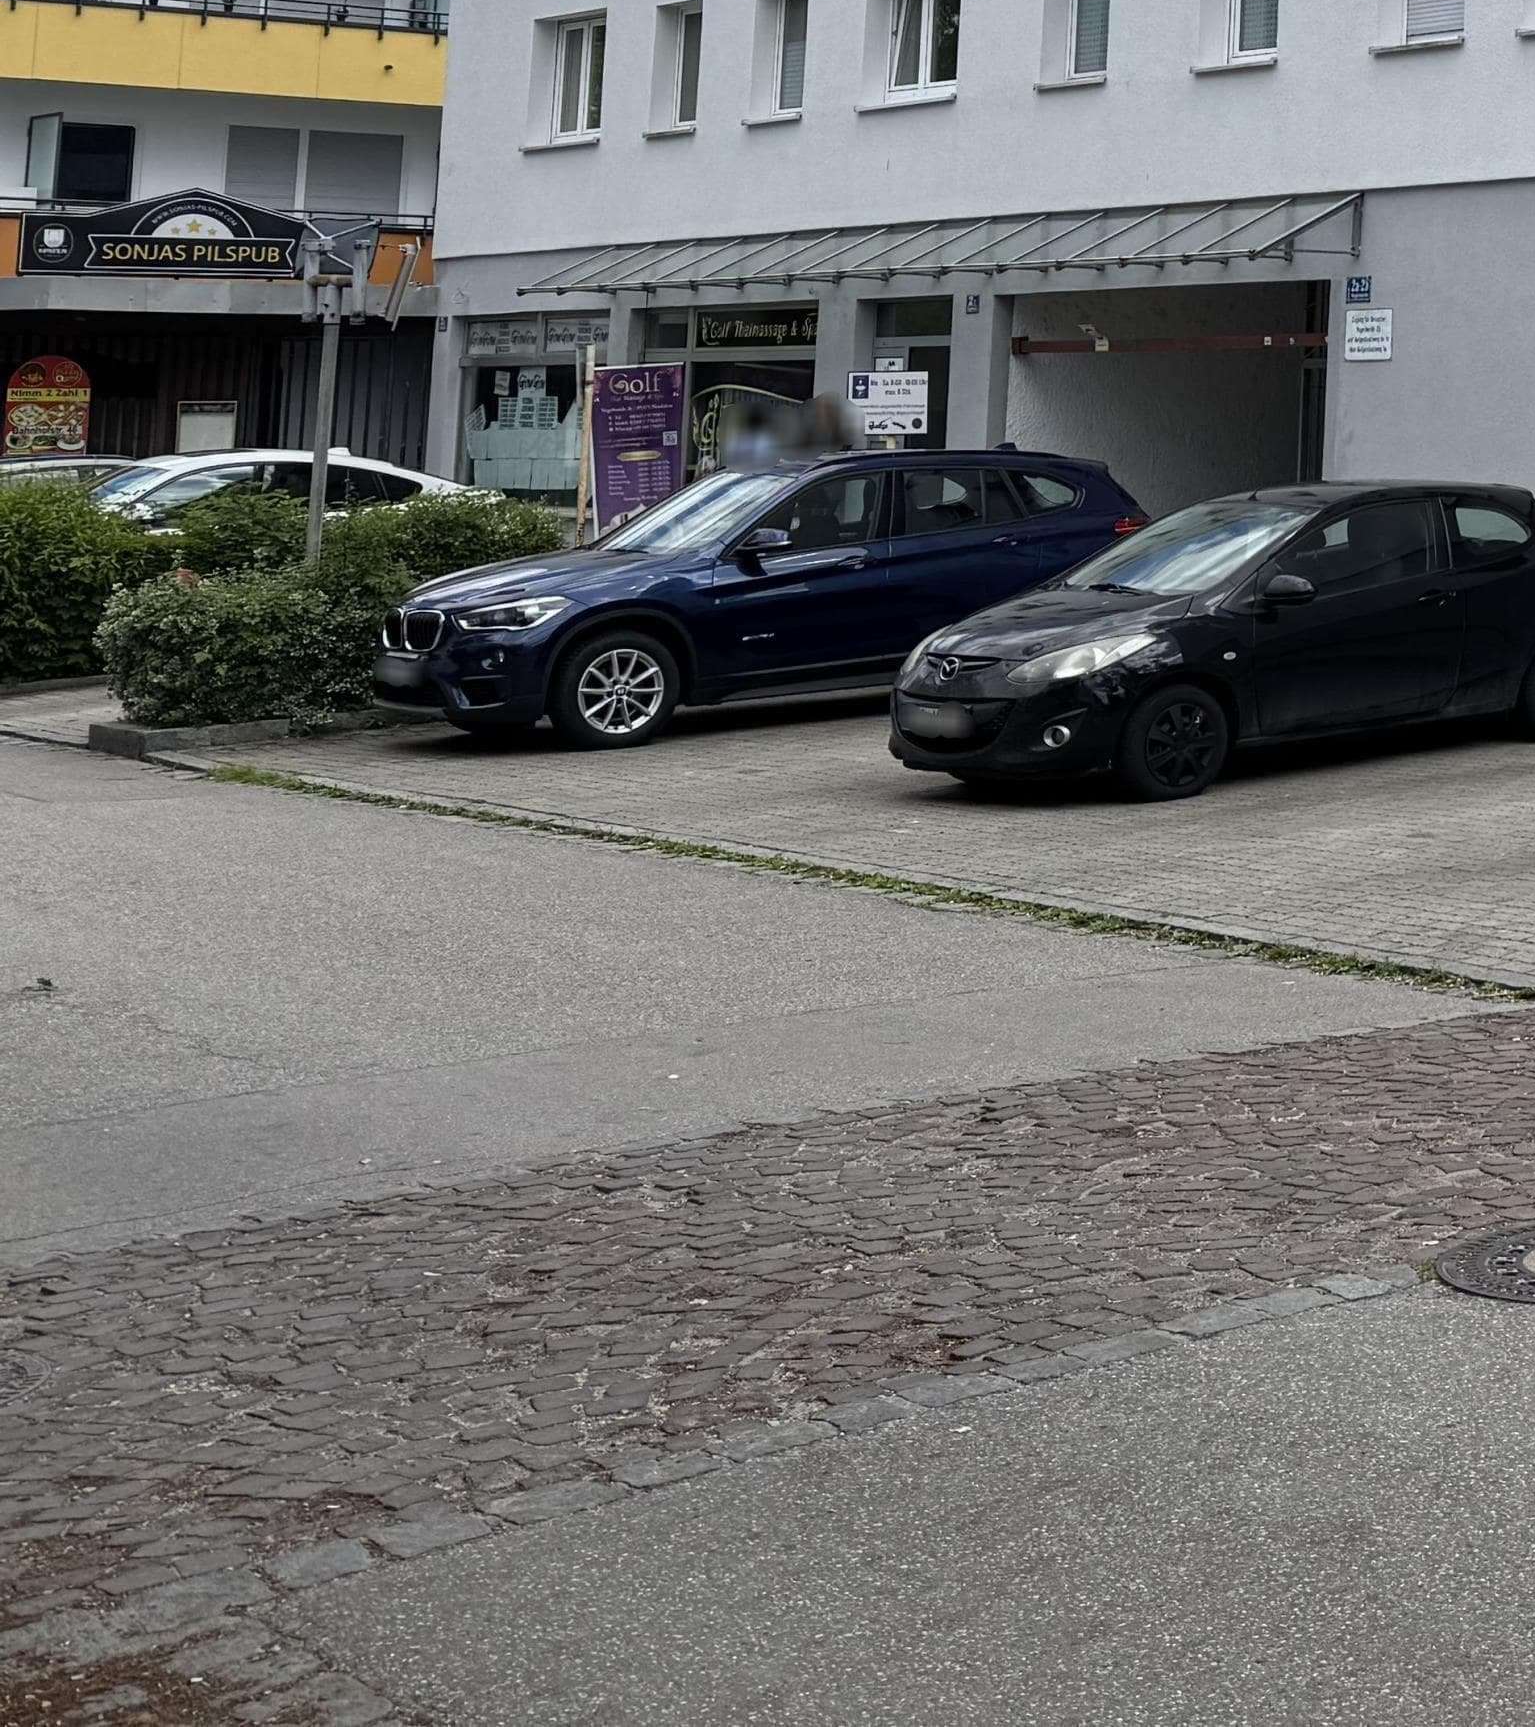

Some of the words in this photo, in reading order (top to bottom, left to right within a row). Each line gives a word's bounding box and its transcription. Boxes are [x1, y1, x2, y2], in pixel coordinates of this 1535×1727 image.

[101, 242, 187, 262] SONJAS
[192, 245, 280, 263] PILSPUB
[609, 372, 663, 394] Golf
